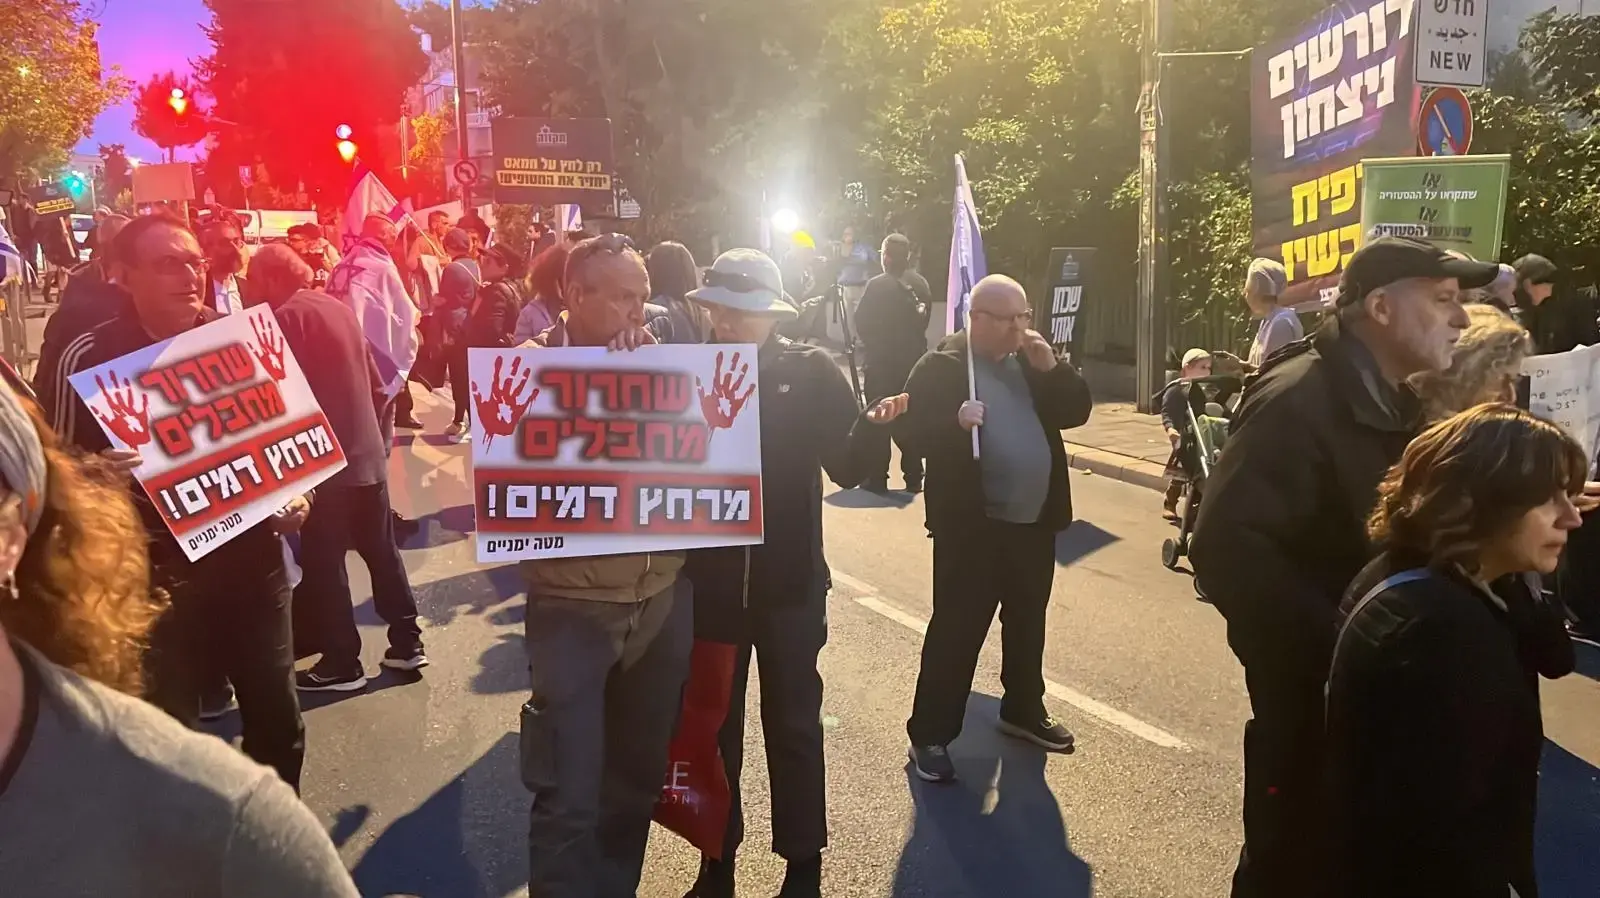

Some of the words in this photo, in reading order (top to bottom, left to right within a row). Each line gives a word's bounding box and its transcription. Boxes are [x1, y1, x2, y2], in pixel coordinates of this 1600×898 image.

[1430, 50, 1472, 71] NEW
[1281, 56, 1396, 159] ניצחון
[503, 157, 538, 169] חמאס
[541, 157, 557, 171] על
[560, 158, 583, 173] לחץ
[586, 161, 602, 174] רק
[558, 175, 575, 187] את
[1292, 163, 1363, 226] פיח
[1424, 189, 1438, 200] על
[1281, 223, 1361, 282] כשיו
[140, 344, 256, 404] שחרור
[541, 371, 688, 411] שחרור
[154, 381, 286, 456] מחבלים
[522, 415, 707, 460] מחבלים
[264, 425, 335, 480] מרחץ
[160, 454, 263, 520] דמים!
[488, 484, 618, 519] דמים!
[639, 487, 750, 525] מרחץ
[220, 511, 243, 534] מטה
[188, 529, 220, 551] ימניים
[487, 537, 529, 553] ימניים
[534, 535, 564, 551] מטה
